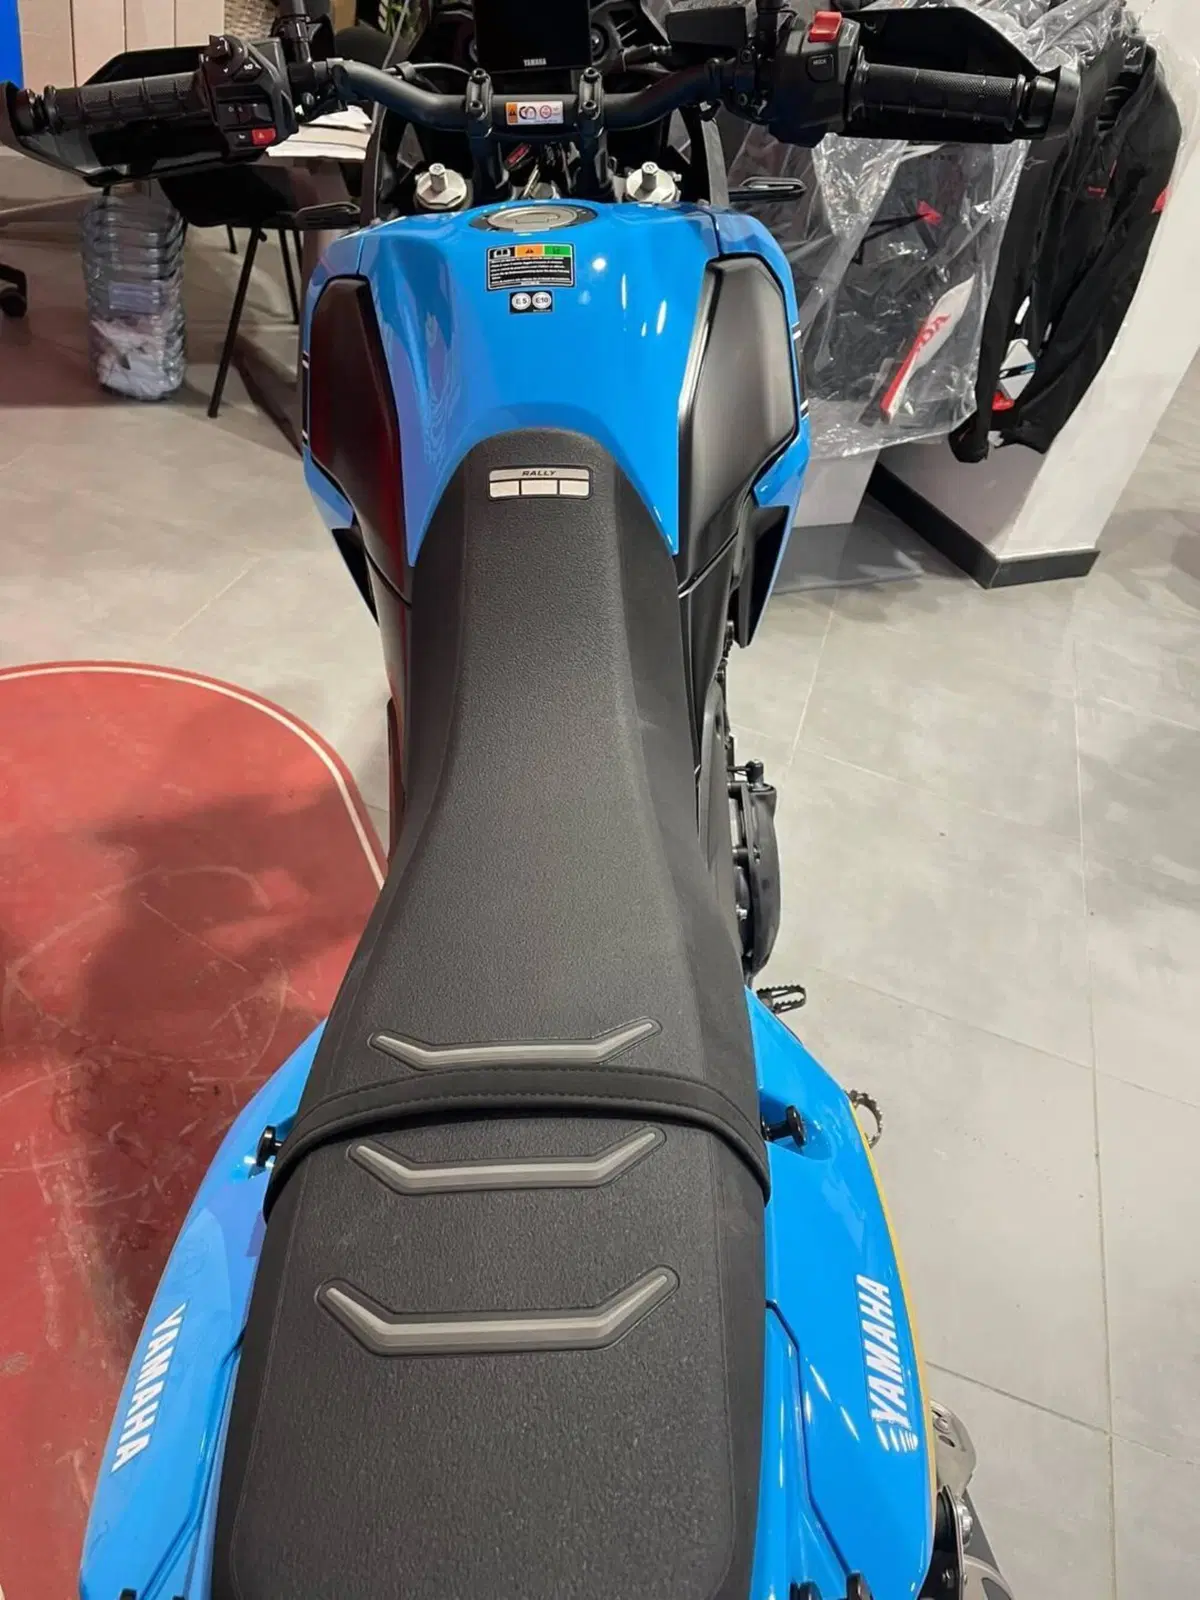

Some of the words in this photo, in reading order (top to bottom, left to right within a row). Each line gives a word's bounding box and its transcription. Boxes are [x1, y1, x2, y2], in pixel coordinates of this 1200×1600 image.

[523, 58, 547, 67] YAMAHA
[110, 1302, 186, 1473] YAMAHA
[856, 1274, 911, 1429] YAMAHA
